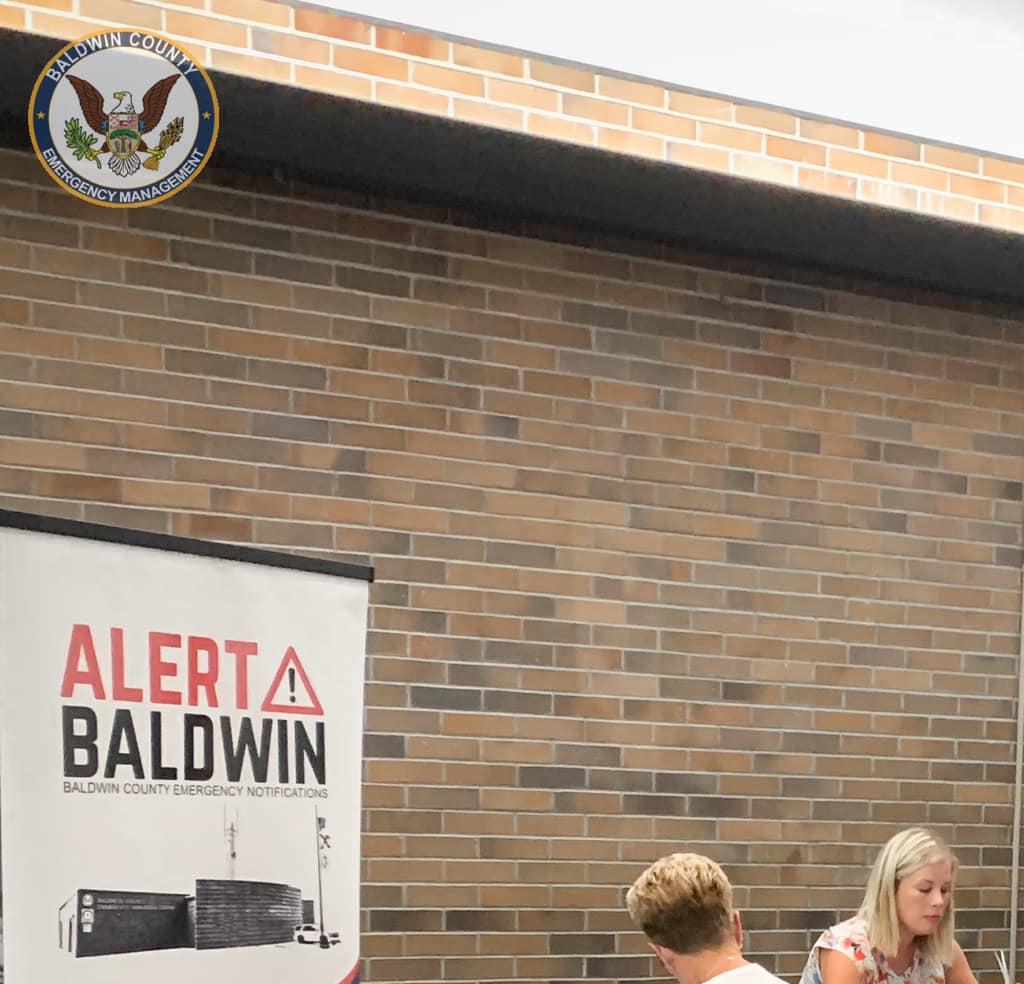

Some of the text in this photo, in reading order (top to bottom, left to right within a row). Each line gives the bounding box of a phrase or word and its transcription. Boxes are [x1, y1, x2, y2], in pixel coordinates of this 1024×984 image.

[60, 623, 258, 709] ALERT
[61, 704, 326, 785] BALDWIN
[63, 781, 328, 799] BALDWIN COUNTY EMERGENCY NOTIFICATIONS
